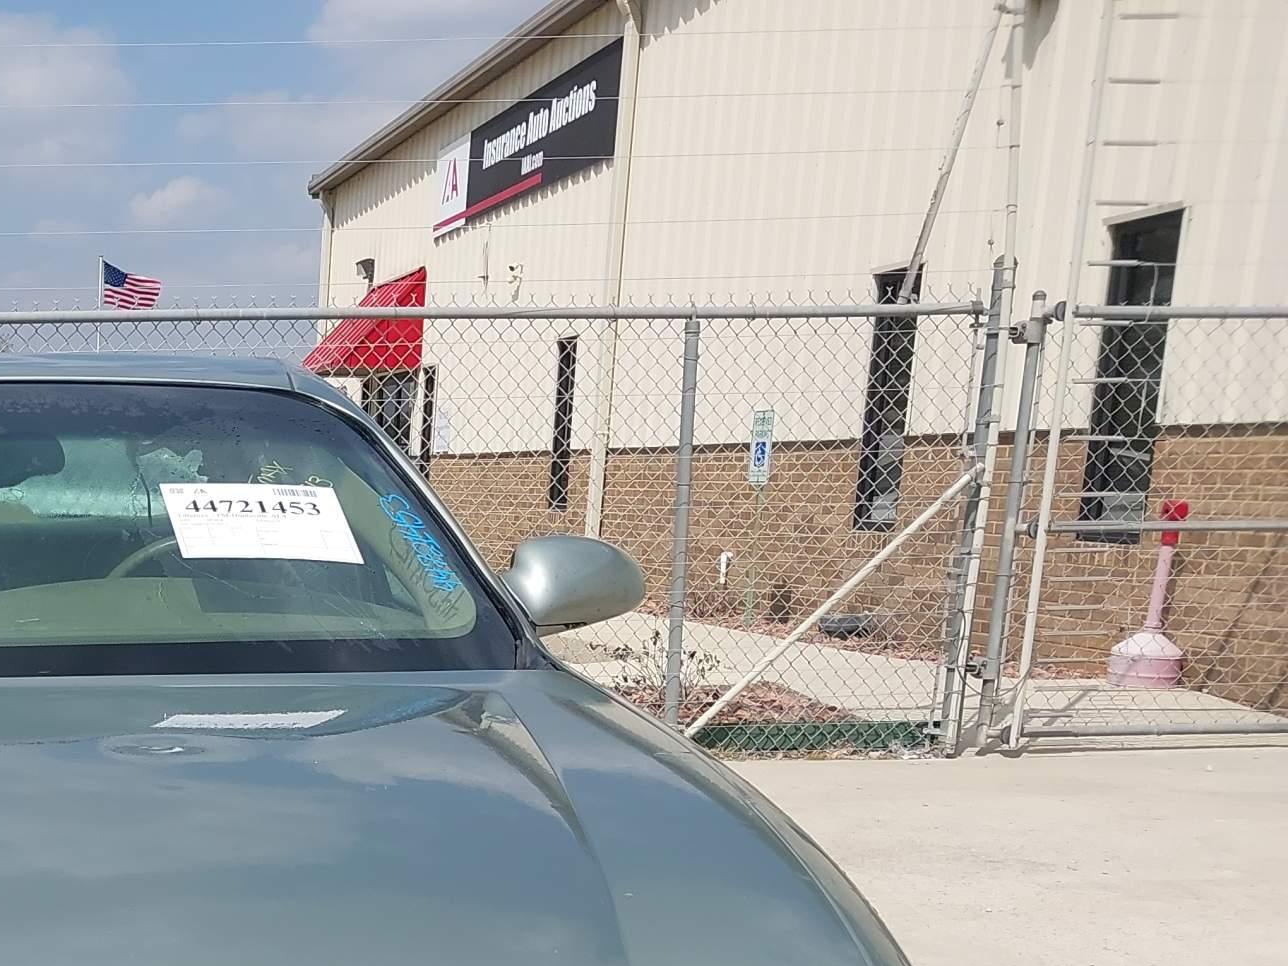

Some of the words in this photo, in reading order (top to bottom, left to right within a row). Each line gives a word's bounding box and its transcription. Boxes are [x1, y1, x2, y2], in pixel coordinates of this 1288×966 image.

[482, 121, 527, 170] Insurance
[526, 107, 550, 146] Auto
[548, 80, 597, 134] Auctions
[184, 500, 321, 516] 44721453
